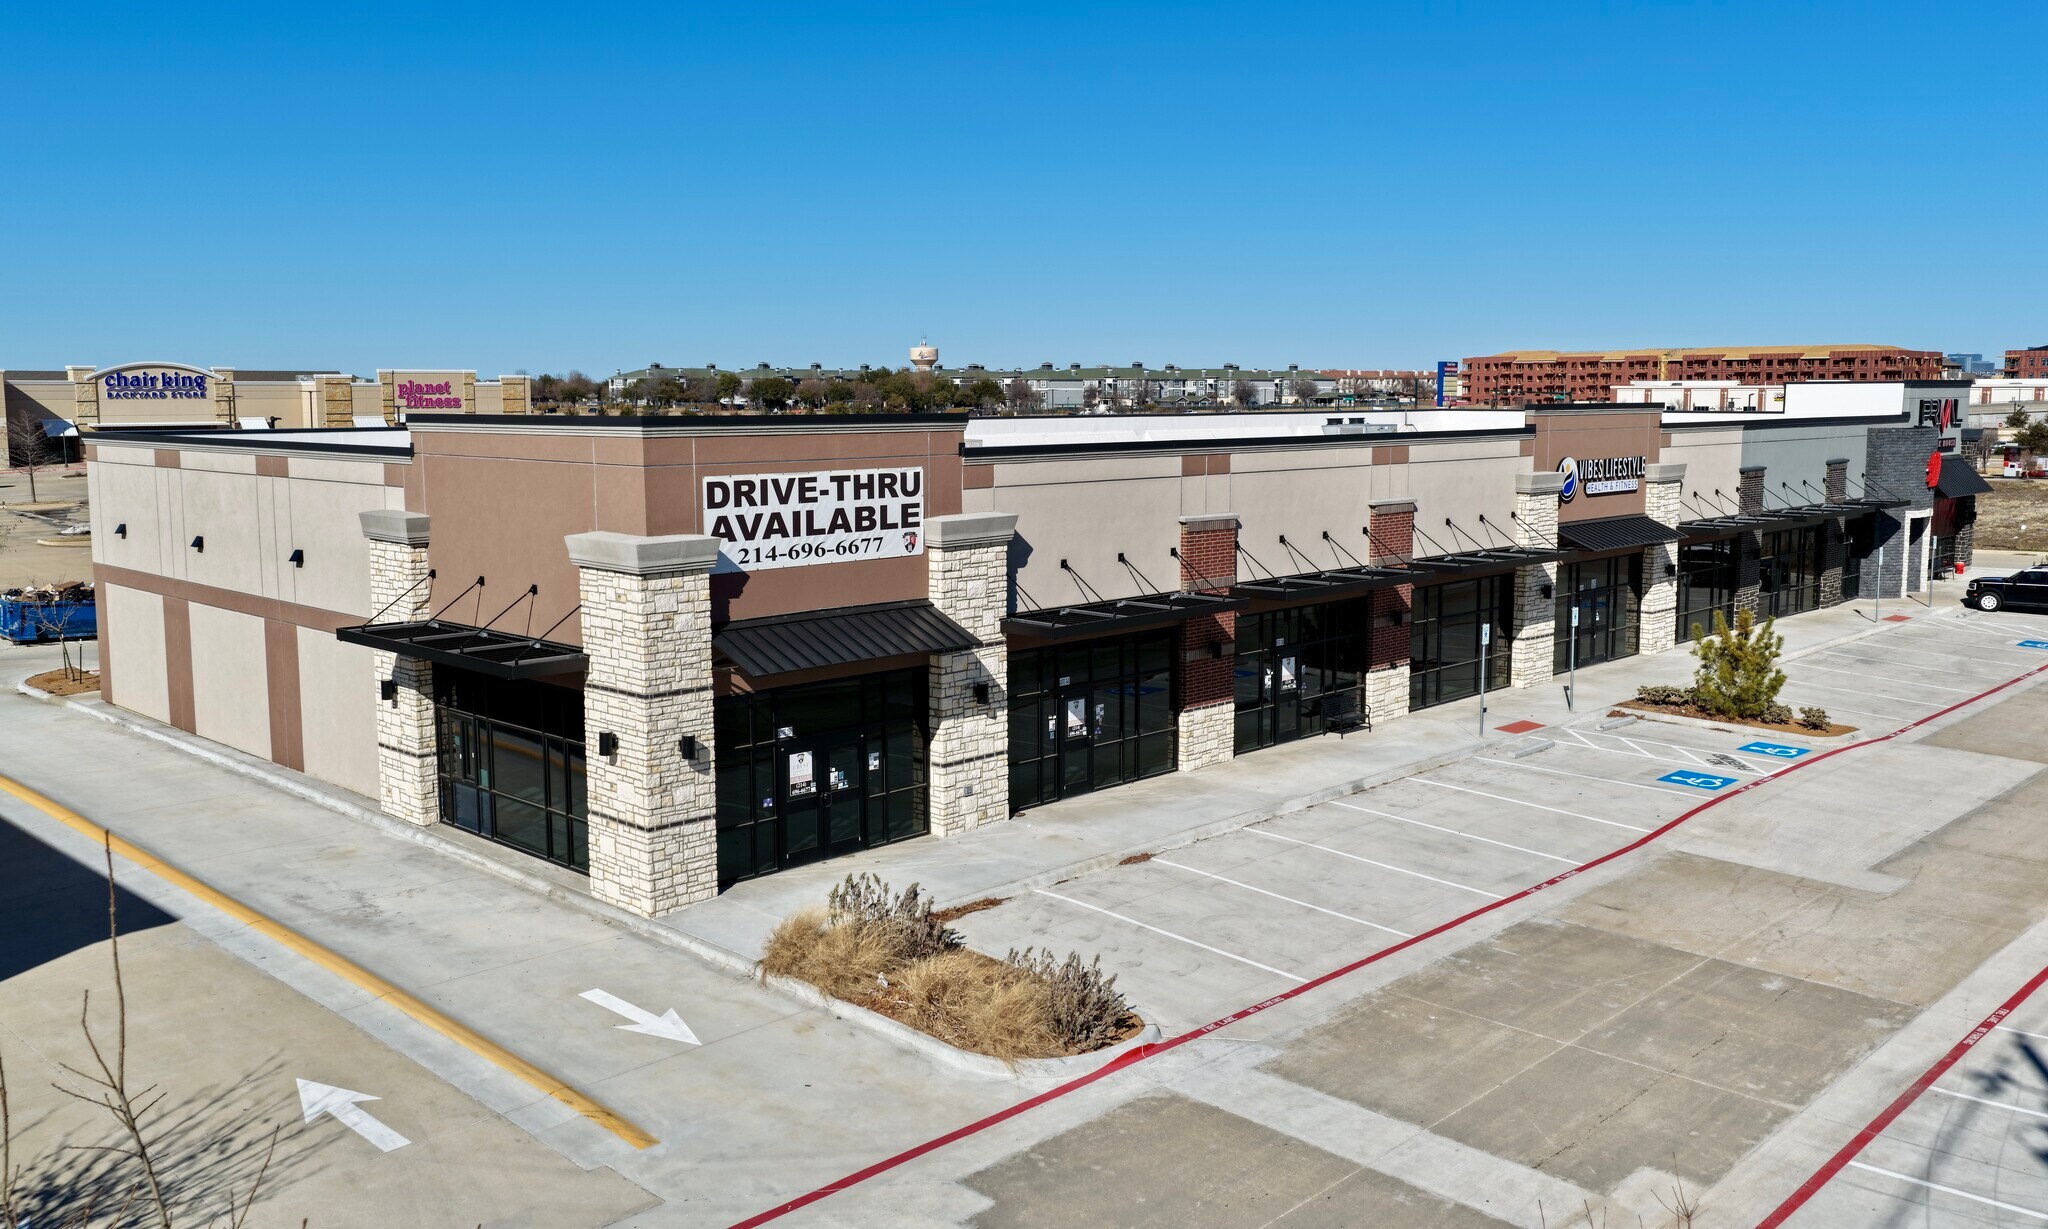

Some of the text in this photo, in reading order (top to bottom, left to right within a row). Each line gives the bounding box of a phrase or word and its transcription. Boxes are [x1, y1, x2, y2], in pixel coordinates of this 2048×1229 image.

[105, 371, 206, 391] chair king
[398, 380, 451, 398] planet
[107, 391, 207, 399] BACKYARD STORE
[405, 394, 462, 408] fitness
[1579, 456, 1646, 480] VIBES LIFESTYLE
[706, 471, 921, 509] DRIVE-THRU
[1587, 482, 1608, 492] HEALTH
[1615, 480, 1638, 490] FITNESS
[710, 503, 921, 542] AVAILABLE
[737, 537, 884, 565] 214-696-6677
